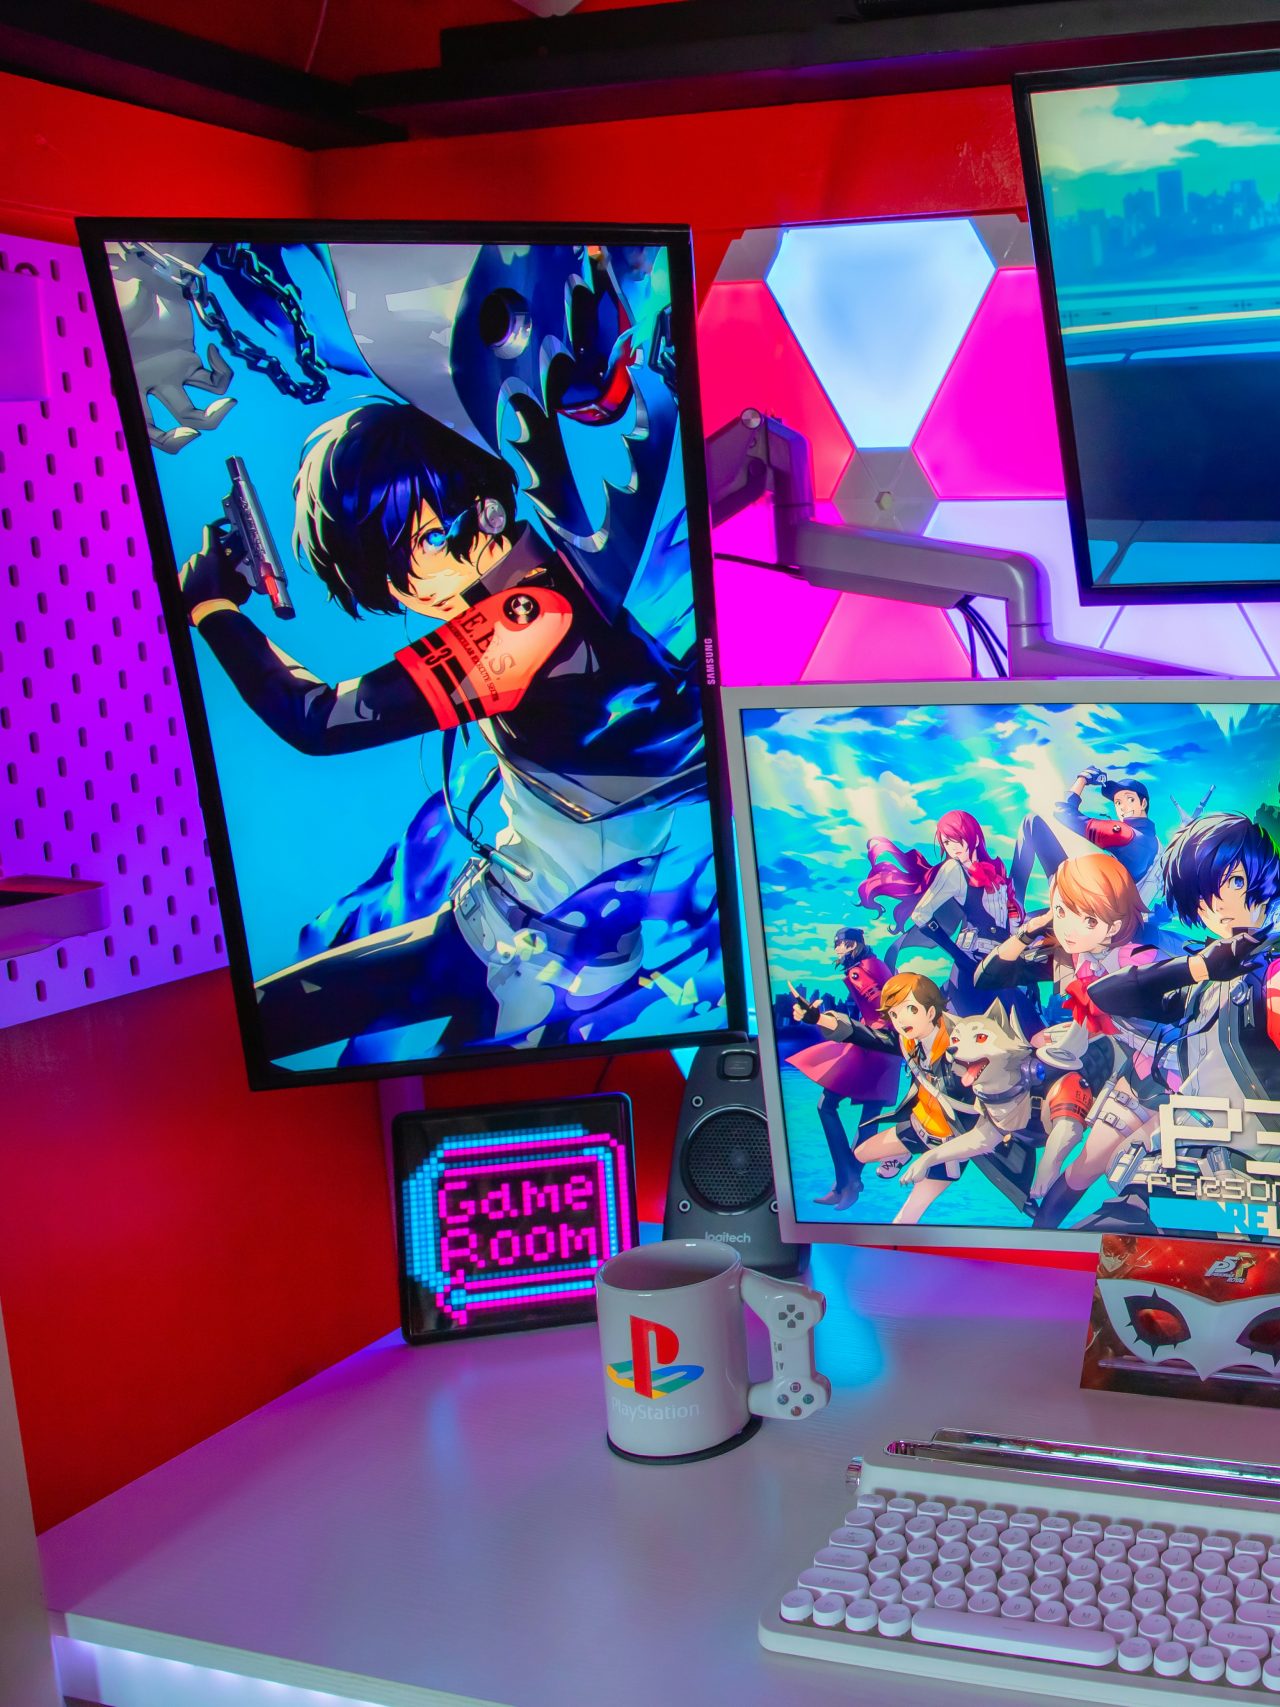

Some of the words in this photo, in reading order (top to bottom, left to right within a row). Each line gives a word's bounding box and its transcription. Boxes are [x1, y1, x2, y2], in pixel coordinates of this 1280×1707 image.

[425, 647, 453, 666] 3
[704, 638, 716, 685] SAMSUNG
[437, 1175, 594, 1224] Game
[611, 1396, 700, 1422] PlayStation
